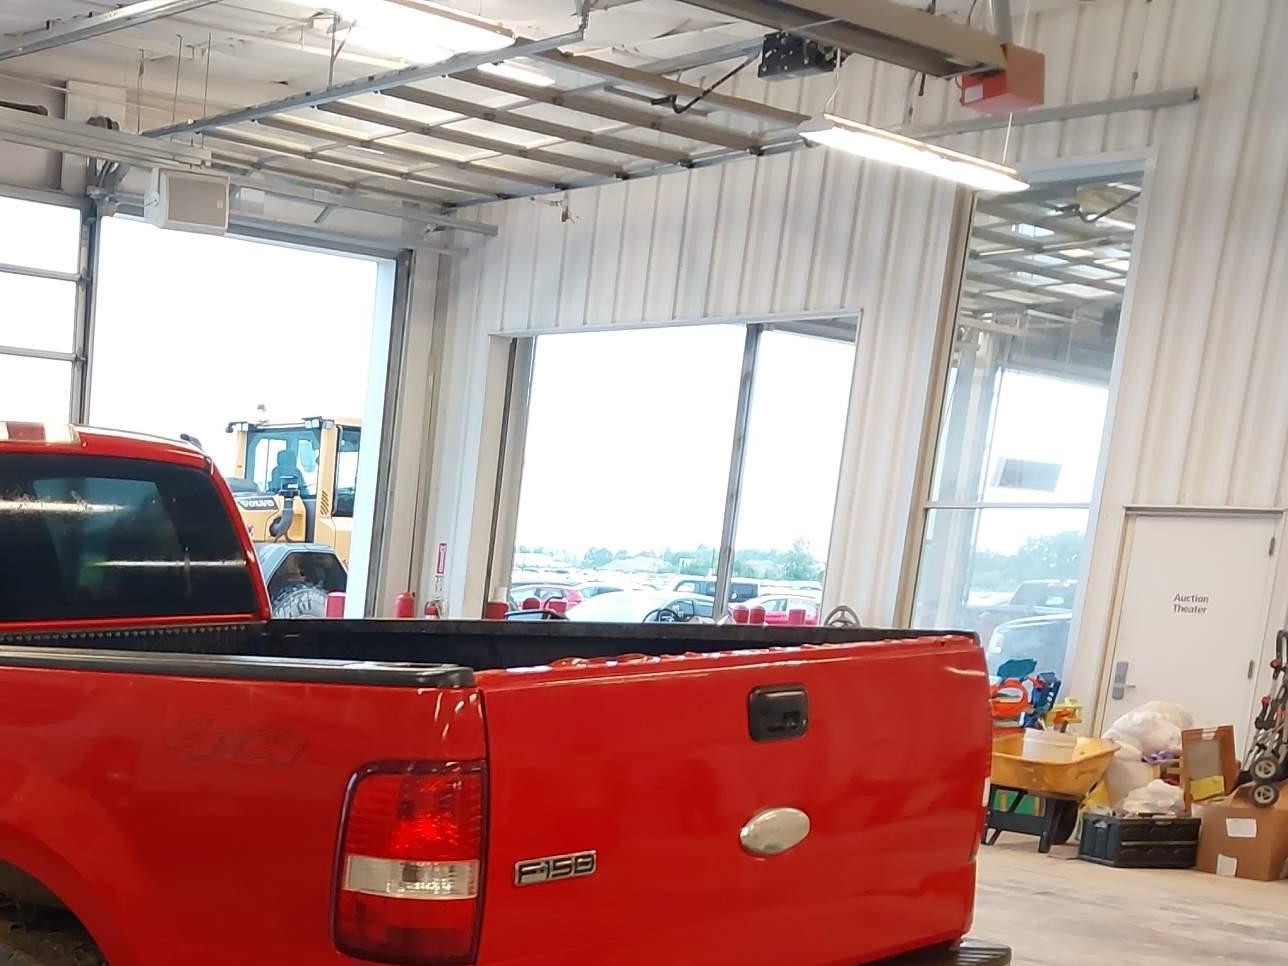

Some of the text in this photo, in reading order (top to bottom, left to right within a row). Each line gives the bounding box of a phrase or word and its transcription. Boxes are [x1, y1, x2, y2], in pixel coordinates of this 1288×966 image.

[241, 498, 275, 508] VOLVO
[1173, 593, 1209, 603] Auction
[1173, 604, 1207, 613] Theater
